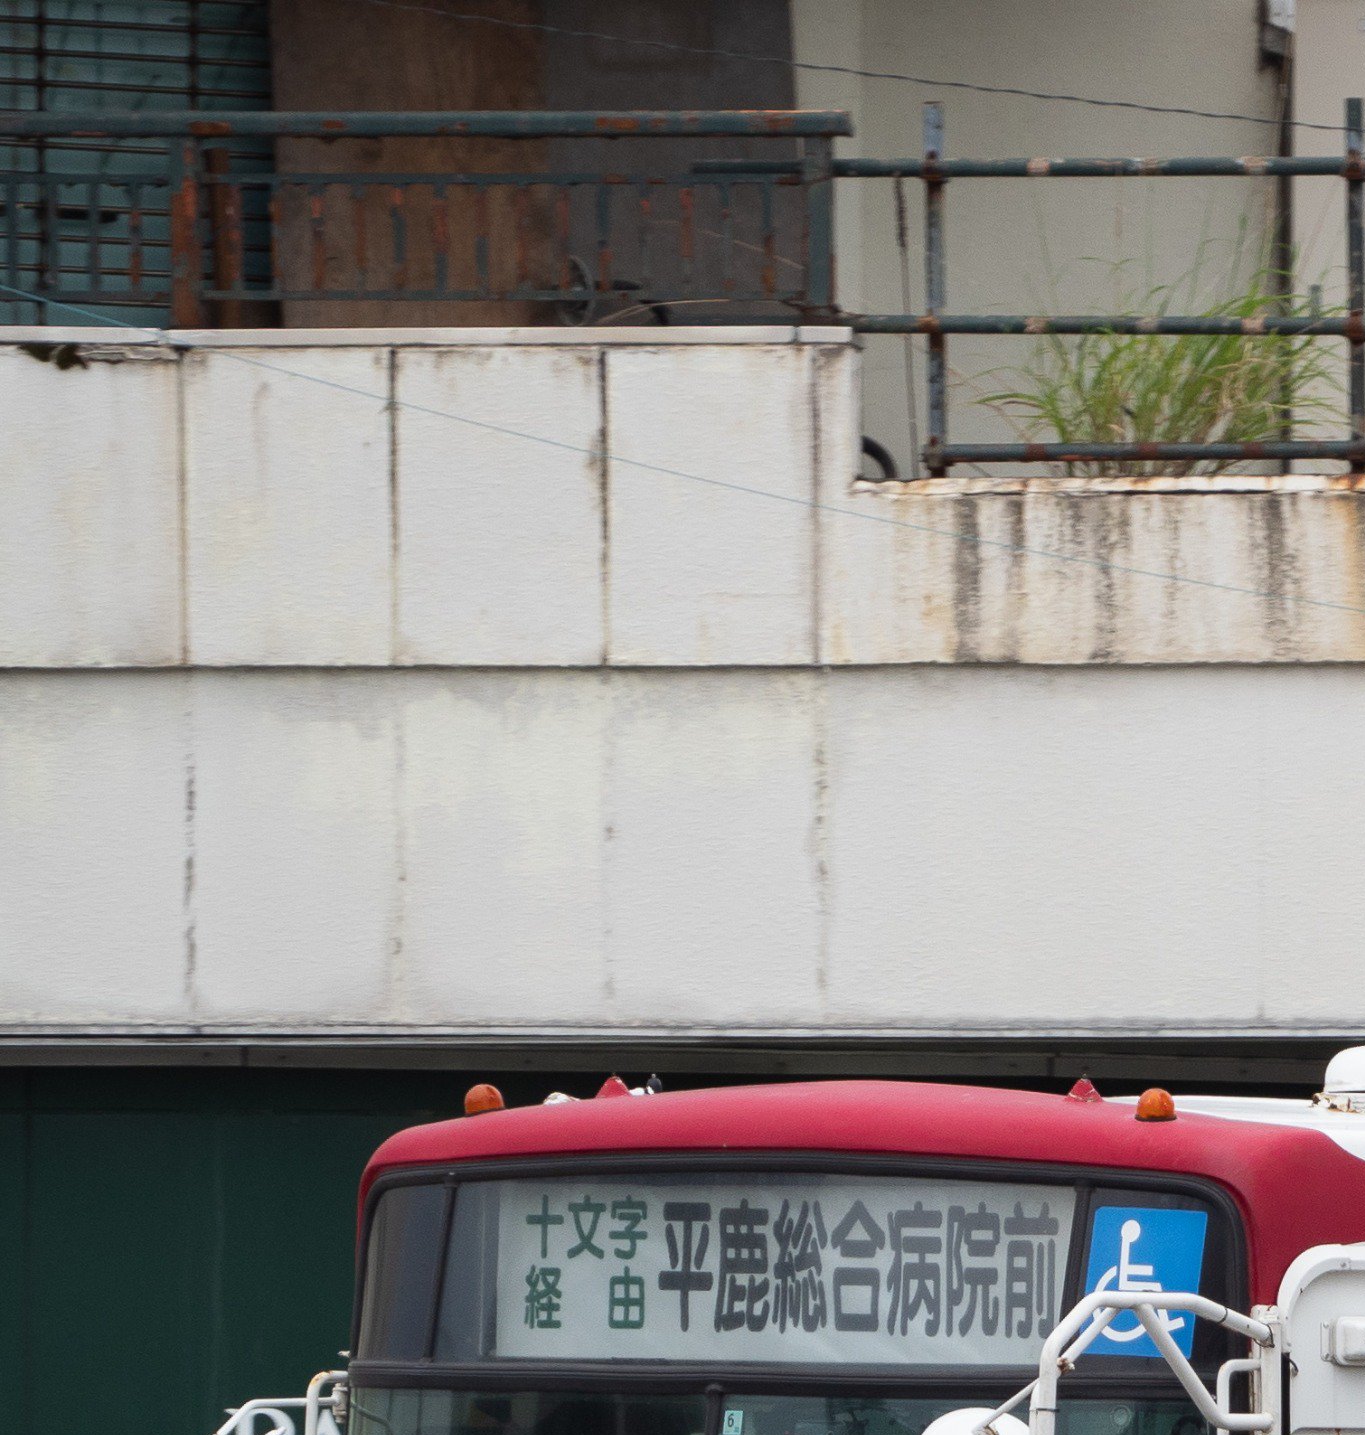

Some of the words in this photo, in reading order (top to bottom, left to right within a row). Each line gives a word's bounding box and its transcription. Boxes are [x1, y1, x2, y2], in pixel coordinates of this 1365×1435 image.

[524, 1195, 648, 1260] 十文字
[524, 1265, 646, 1330] 経由
[658, 1198, 1059, 1340] 平鹿総合病院前
[726, 1412, 736, 1428] 6
